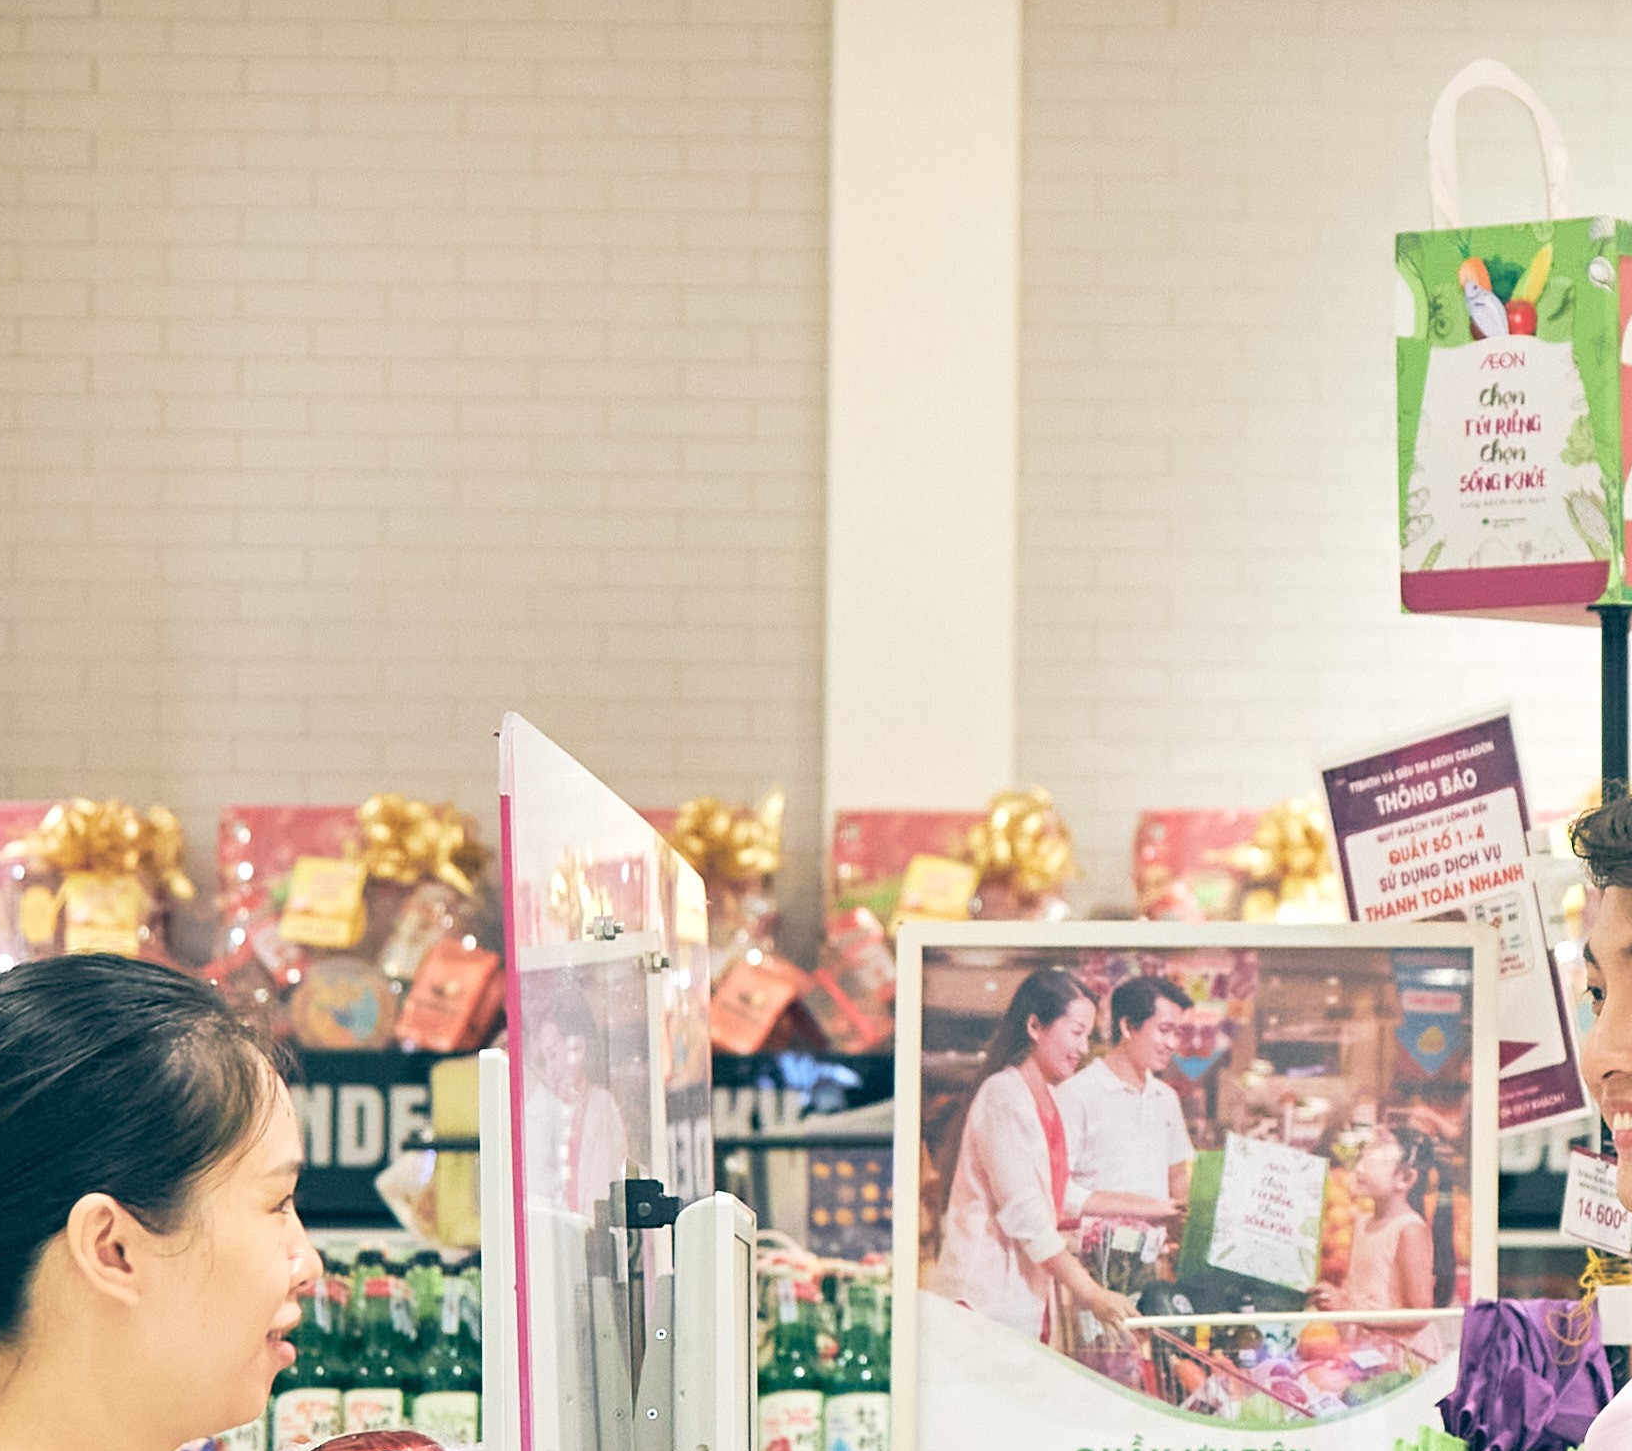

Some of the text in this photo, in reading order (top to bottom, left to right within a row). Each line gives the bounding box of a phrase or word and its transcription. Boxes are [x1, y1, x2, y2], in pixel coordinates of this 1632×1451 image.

[1375, 766, 1478, 816] THÔNG BÁO
[1364, 863, 1526, 923] THANH TOÁN NHANH
